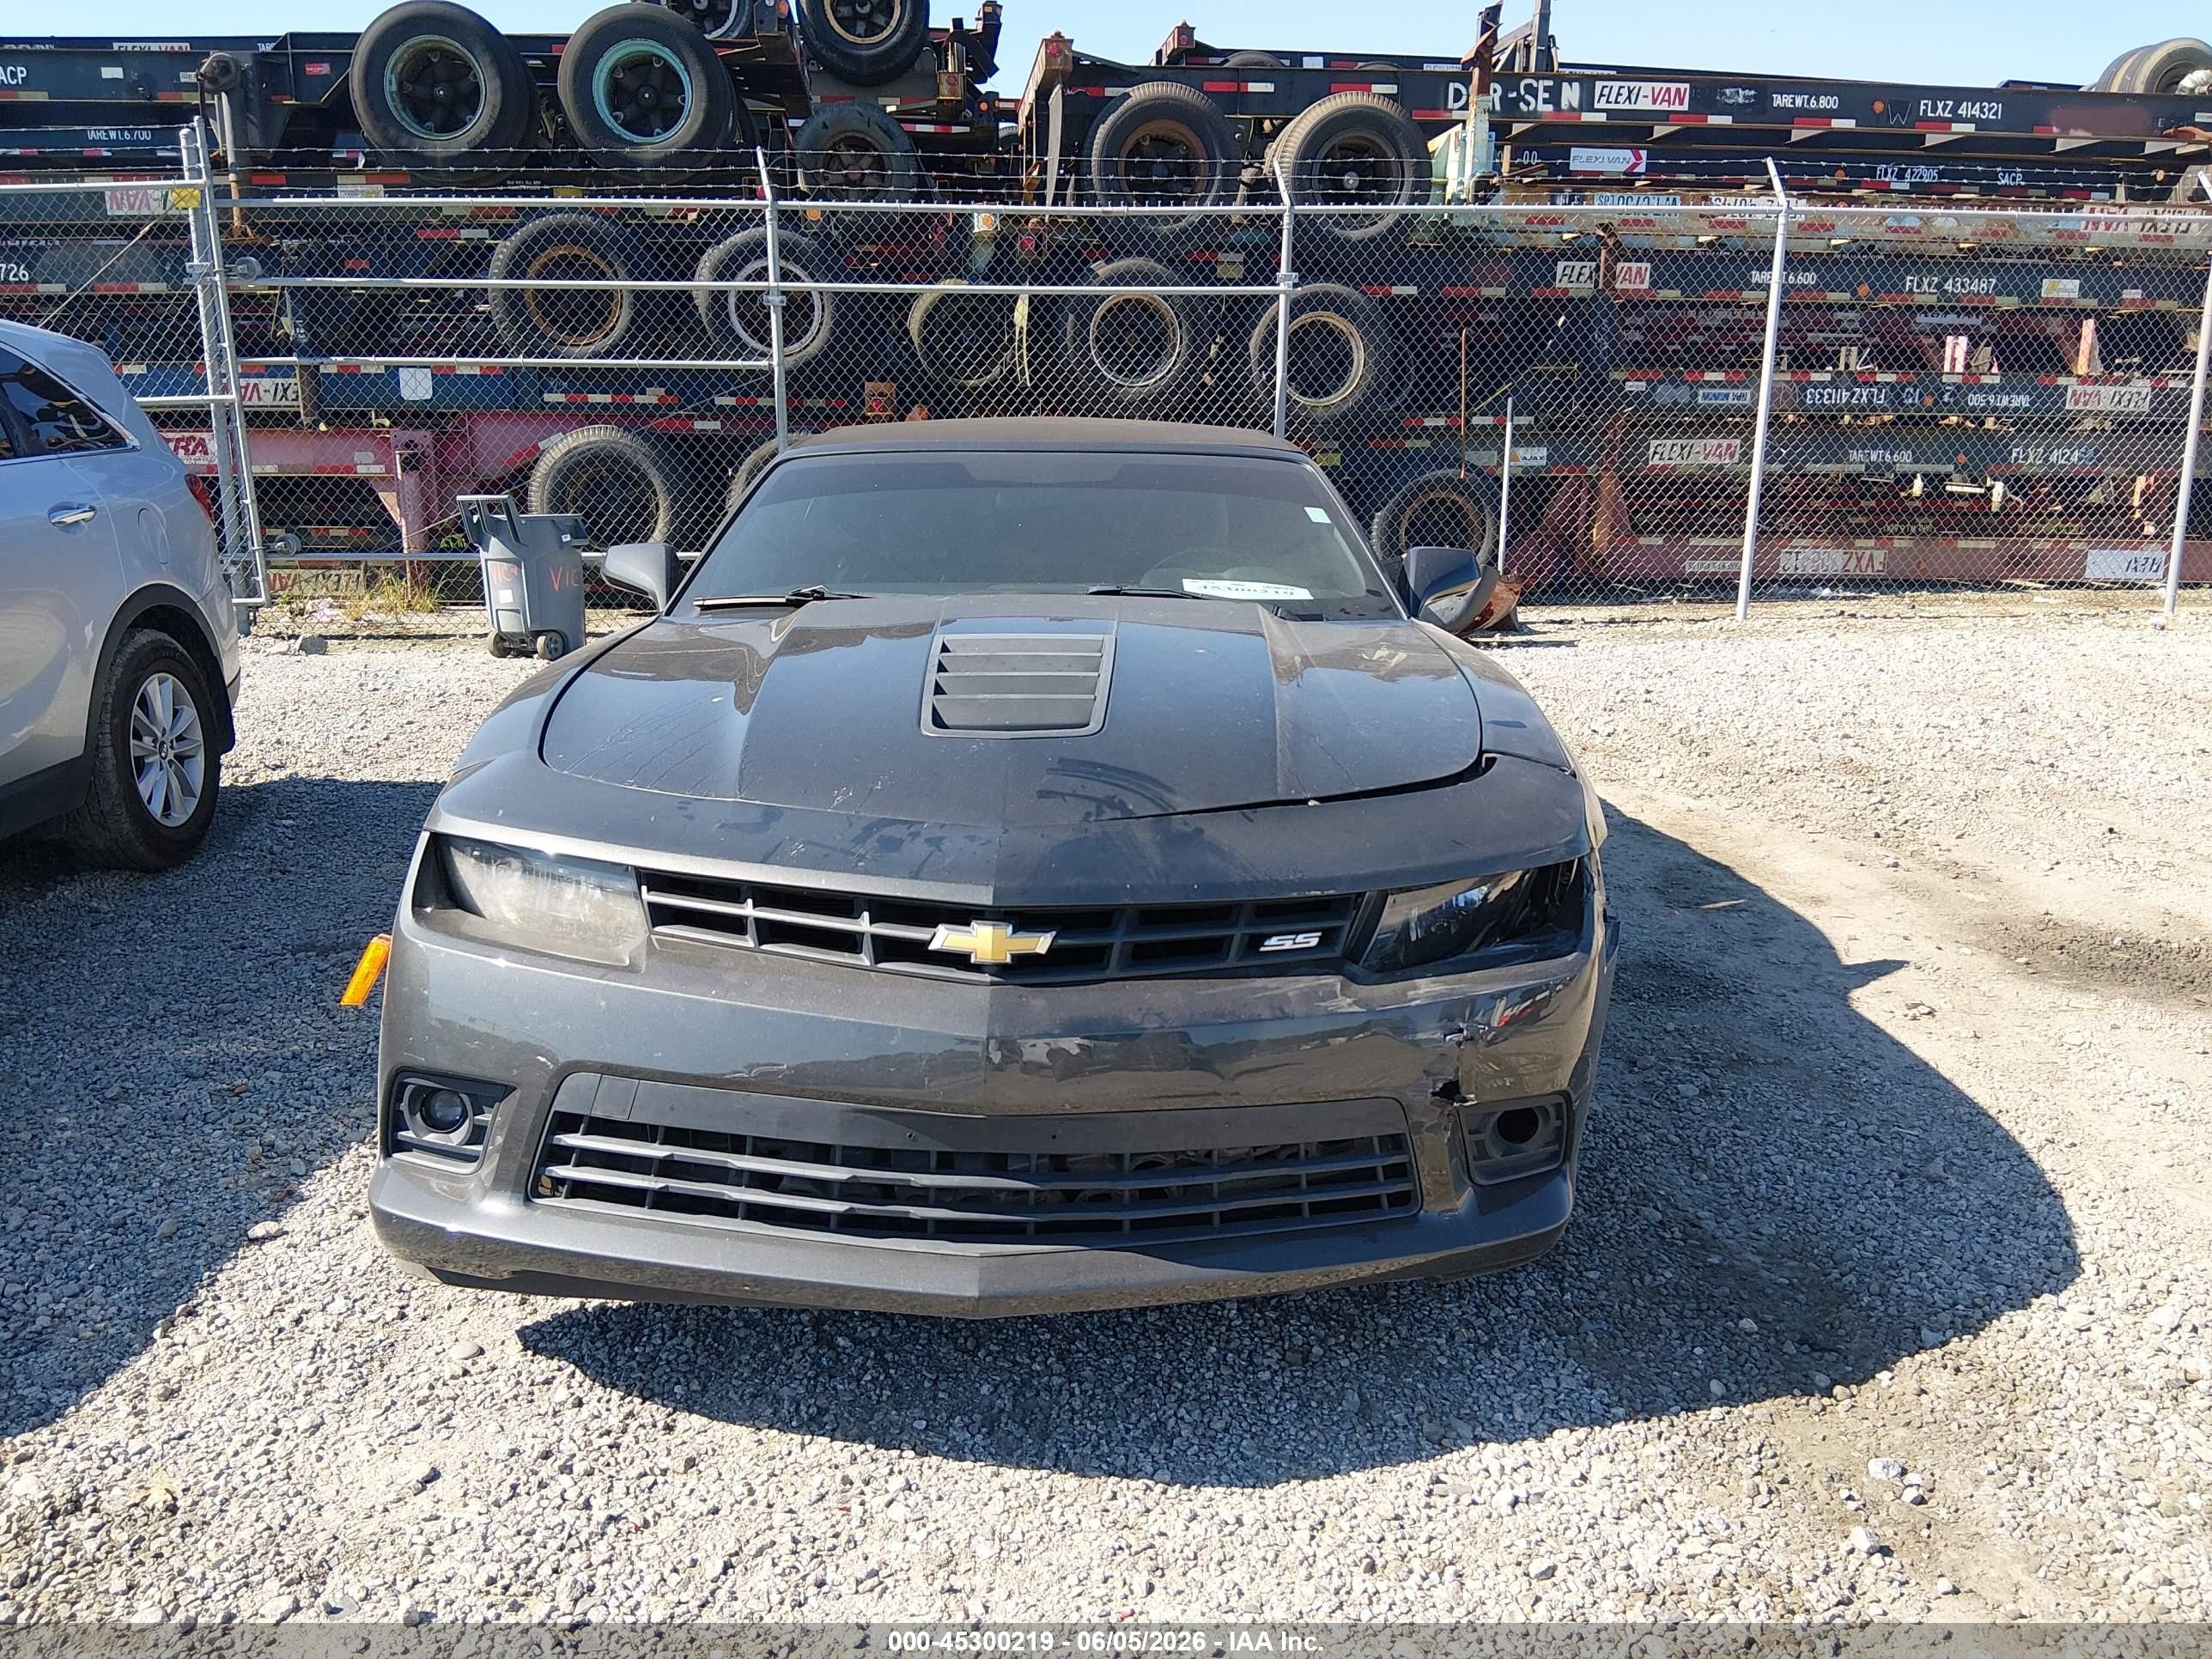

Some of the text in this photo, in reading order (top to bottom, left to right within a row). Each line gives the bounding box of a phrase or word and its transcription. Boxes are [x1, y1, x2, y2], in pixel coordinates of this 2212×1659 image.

[1597, 85, 1687, 106] FLEXI-VAN
[1919, 100, 2002, 119] FLXZ 414321
[1905, 276, 1996, 294] FLXZ 433487
[1650, 442, 1738, 461] FLEXI-VAN
[1259, 932, 1322, 951] SS
